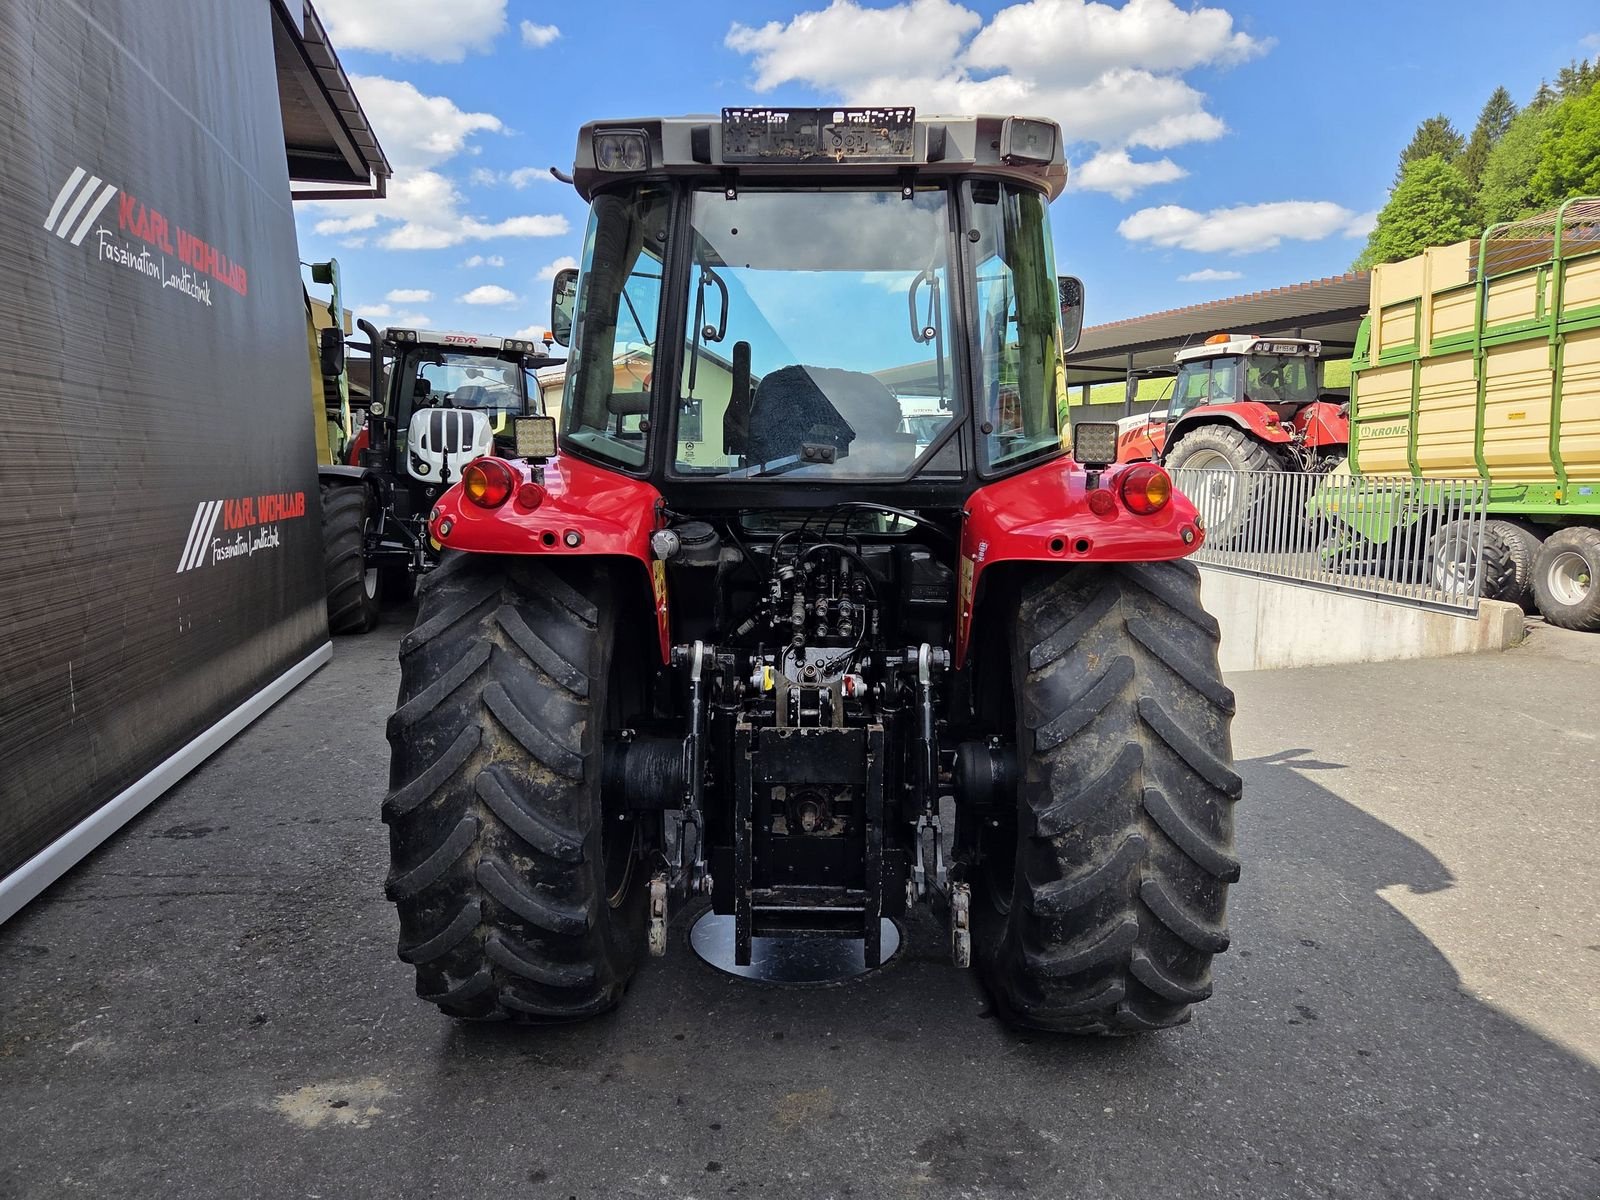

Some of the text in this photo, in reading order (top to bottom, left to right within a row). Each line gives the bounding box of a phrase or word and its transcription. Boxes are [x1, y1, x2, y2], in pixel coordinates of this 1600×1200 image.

[119, 191, 247, 296] KARL WOHLLAIB
[96, 225, 212, 306] Faszination Landtechnik
[444, 335, 478, 345] STEYR
[1370, 424, 1408, 437] KRONE
[223, 497, 257, 531] KARL
[211, 532, 249, 567] Faszination
